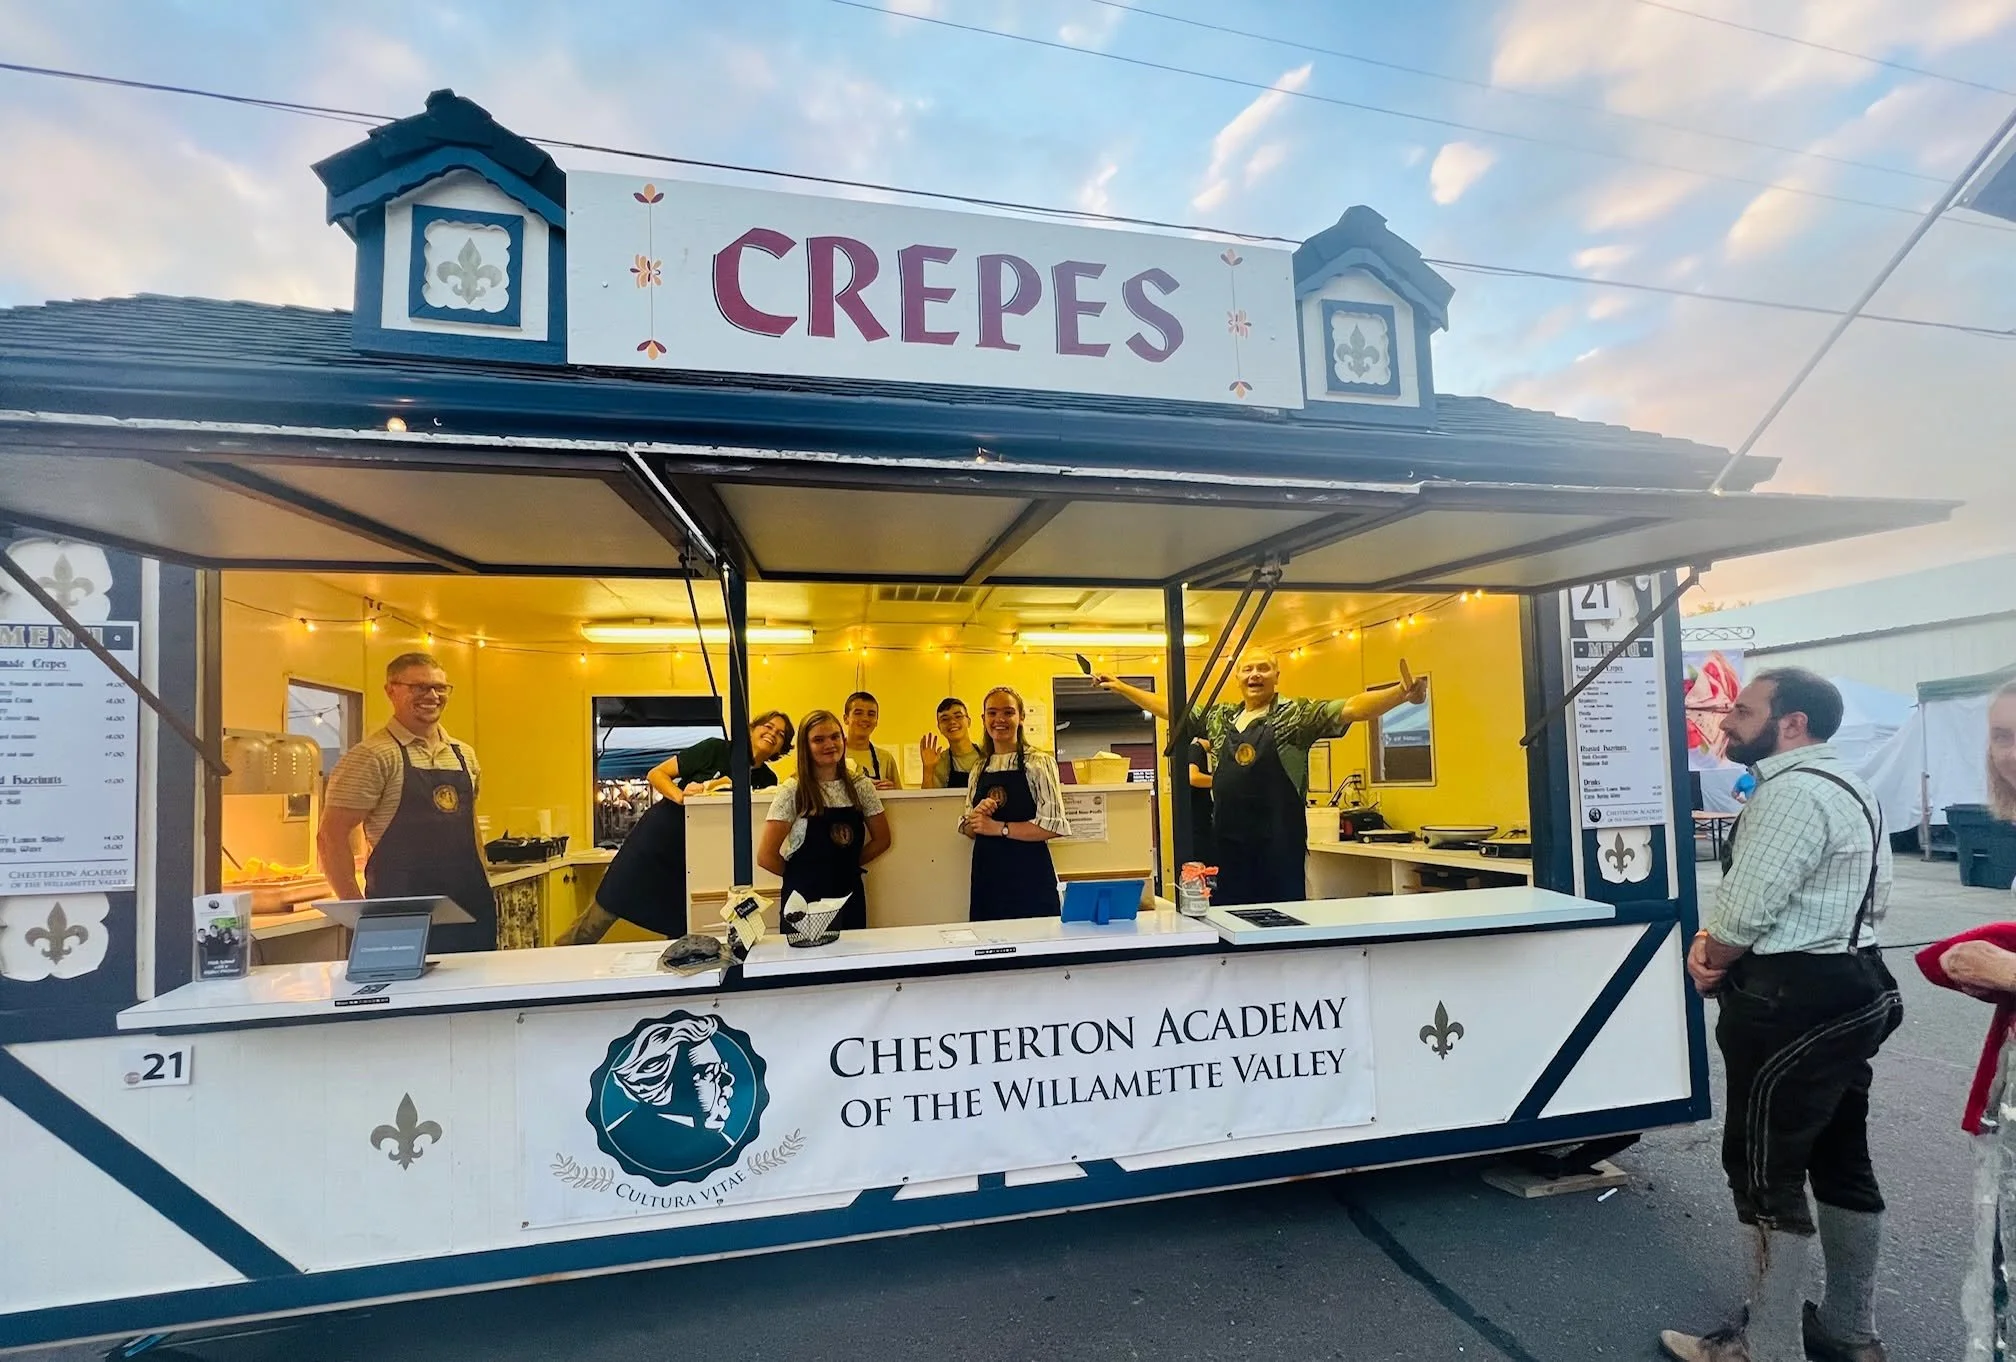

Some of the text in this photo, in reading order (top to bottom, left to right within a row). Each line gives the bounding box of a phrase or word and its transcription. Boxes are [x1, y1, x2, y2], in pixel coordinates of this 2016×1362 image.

[713, 227, 1184, 363] CREPES
[32, 658, 67, 670] Crepes
[1587, 642, 1640, 658] MEU
[8, 868, 129, 880] CHESTERTON ACADEMY
[829, 997, 1348, 1079] CHESTERTON ACADEMY
[142, 1051, 182, 1081] 21
[840, 1048, 1347, 1129] OF THE WILLAMETTE VALLEY
[615, 1169, 748, 1208] CULTURA VITAE
